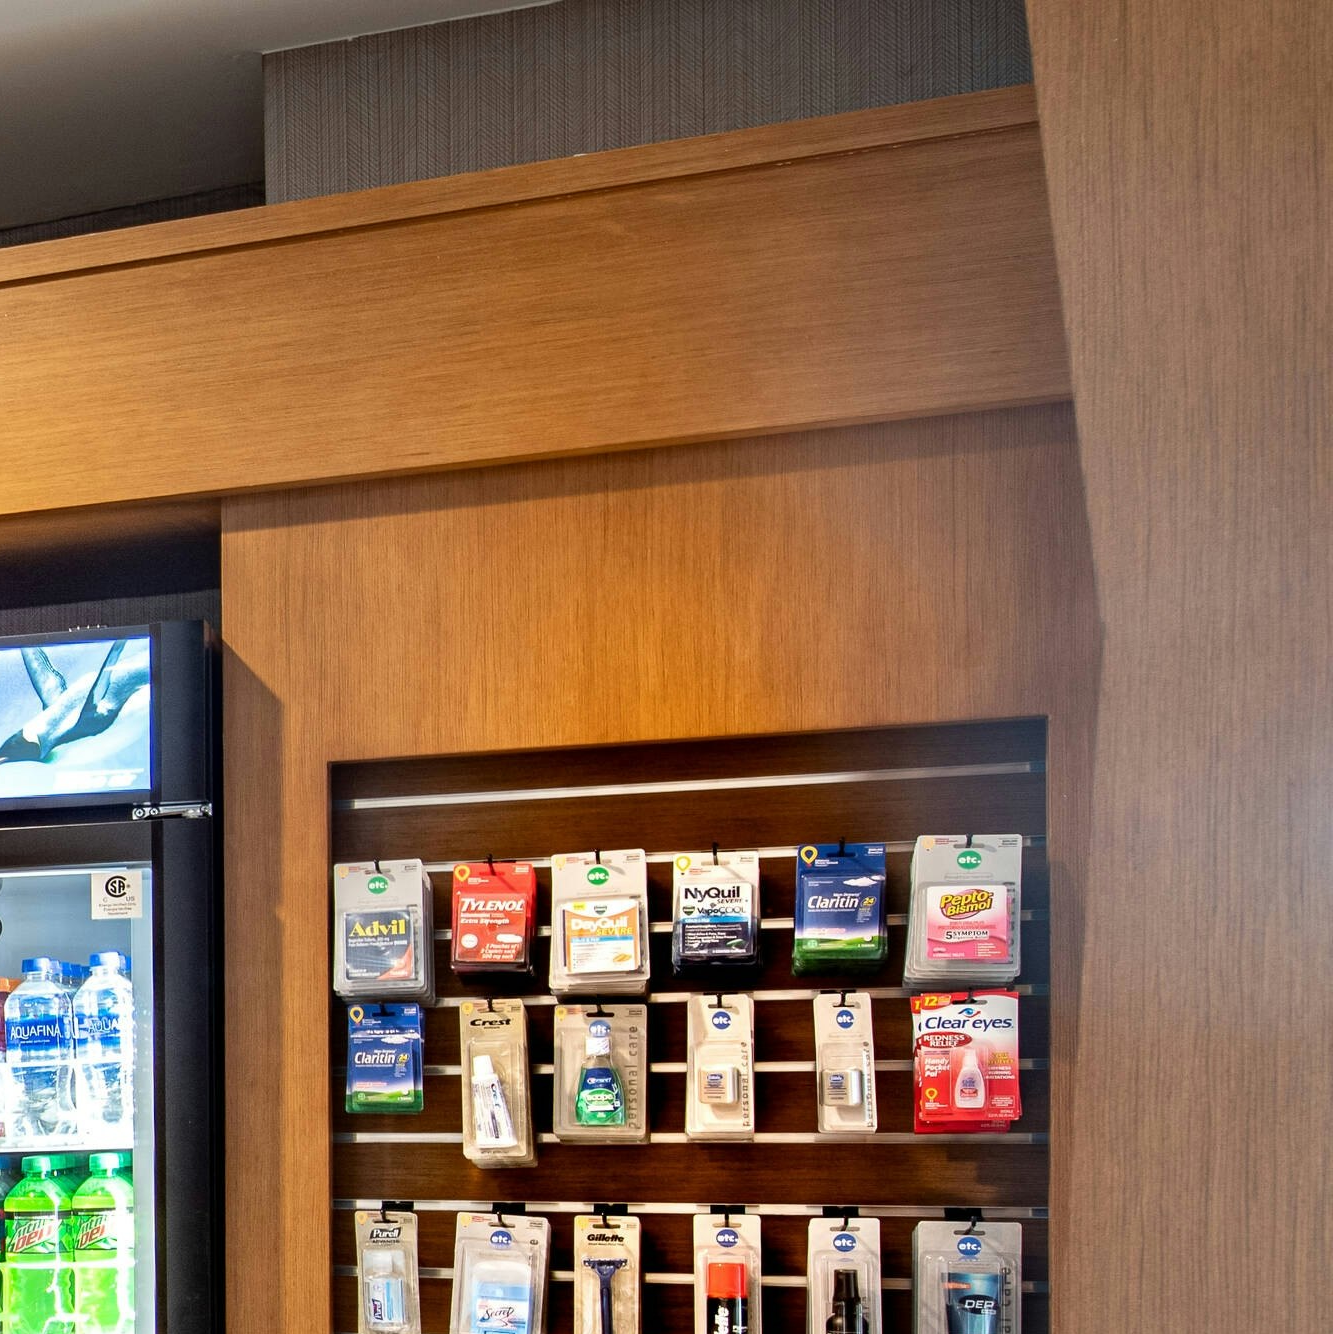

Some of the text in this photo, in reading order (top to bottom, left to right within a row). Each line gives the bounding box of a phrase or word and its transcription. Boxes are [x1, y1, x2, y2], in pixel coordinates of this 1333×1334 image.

[958, 855, 981, 864] etc.
[684, 886, 741, 903] NyQuil
[940, 890, 994, 907] Pepto-
[460, 898, 525, 912] TYLENOL
[807, 895, 860, 909] Claritin
[697, 906, 747, 917] VapoCOOL
[946, 901, 993, 916] Bismol
[479, 917, 510, 925] Strength
[571, 917, 629, 932] DayQuil
[351, 919, 406, 937] Advil
[596, 926, 633, 935] SEVERE
[945, 931, 953, 939] 5
[924, 997, 938, 1006] 12
[470, 1018, 512, 1027] Crest
[925, 1017, 1014, 1031] Clear eyes.
[10, 1023, 61, 1041] AQUAFINA
[923, 1034, 966, 1042] REDNESS
[354, 1052, 396, 1064] Claritin
[924, 1058, 950, 1067] Handy
[924, 1065, 950, 1073] Pocket
[373, 1229, 400, 1238] Purell
[587, 1233, 625, 1243] Gillette
[491, 1235, 511, 1244] etc.
[964, 1299, 995, 1309] DEP
[485, 1307, 515, 1319] Secret
